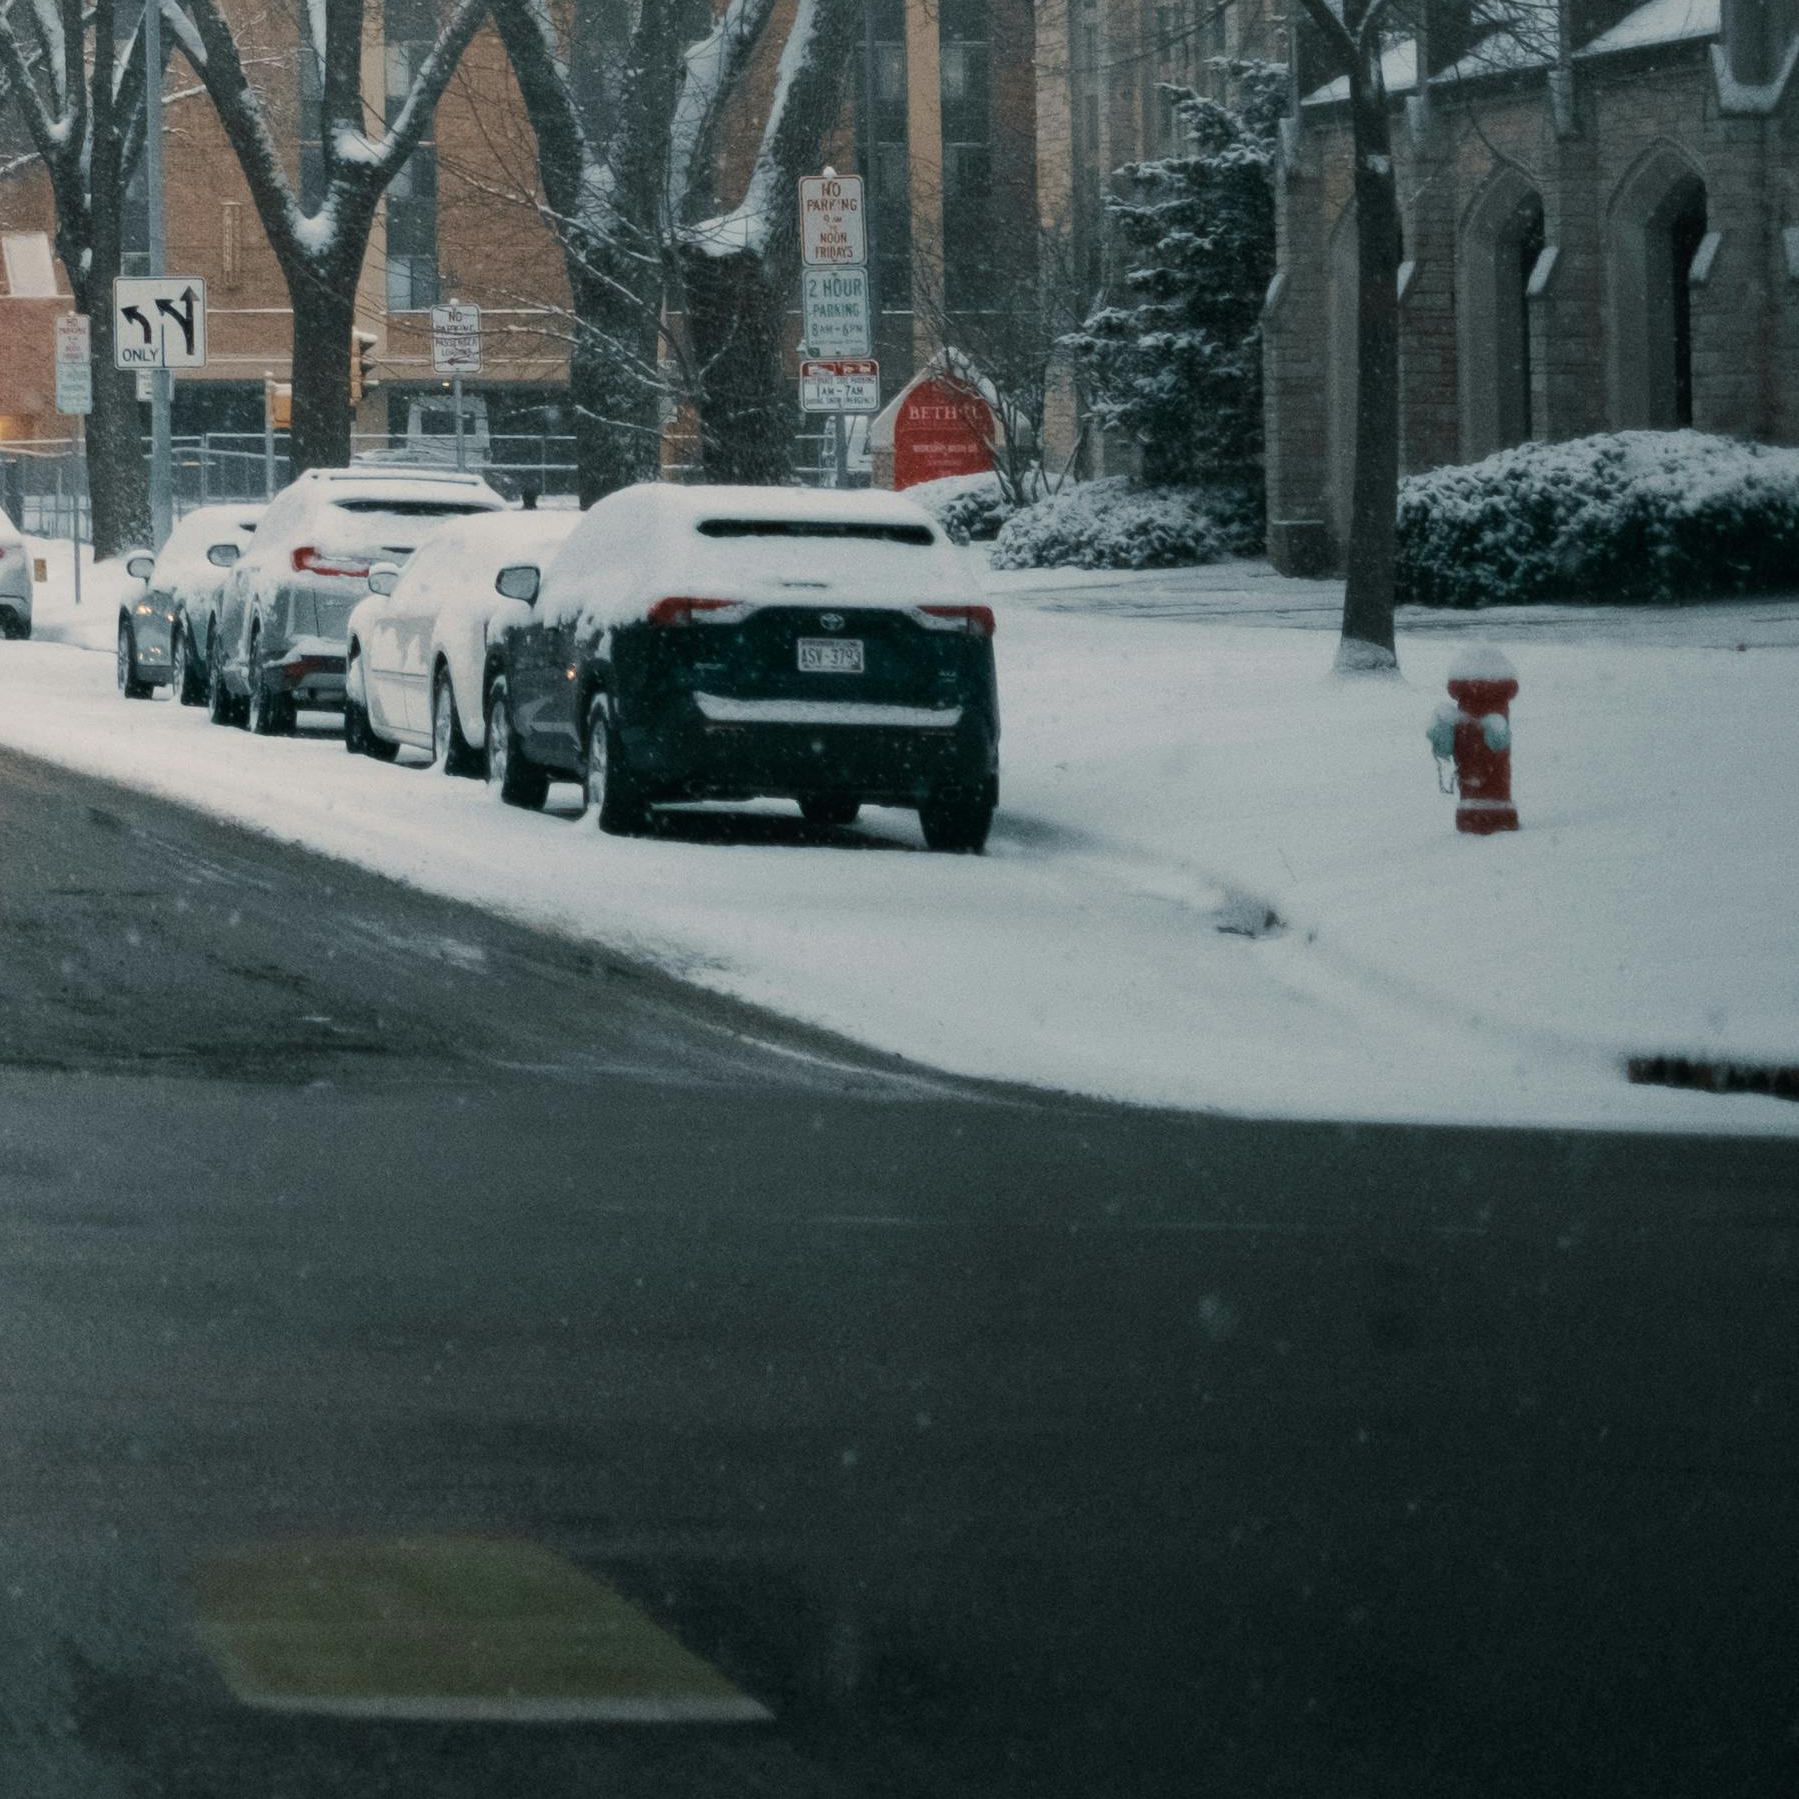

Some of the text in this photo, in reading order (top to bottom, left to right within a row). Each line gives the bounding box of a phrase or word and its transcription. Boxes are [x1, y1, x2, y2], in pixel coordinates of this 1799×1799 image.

[821, 182, 842, 198] NO
[820, 231, 848, 244] NOON
[808, 278, 863, 298] 2 HOUR
[812, 302, 860, 318] PARKING
[121, 348, 160, 362] ONLY
